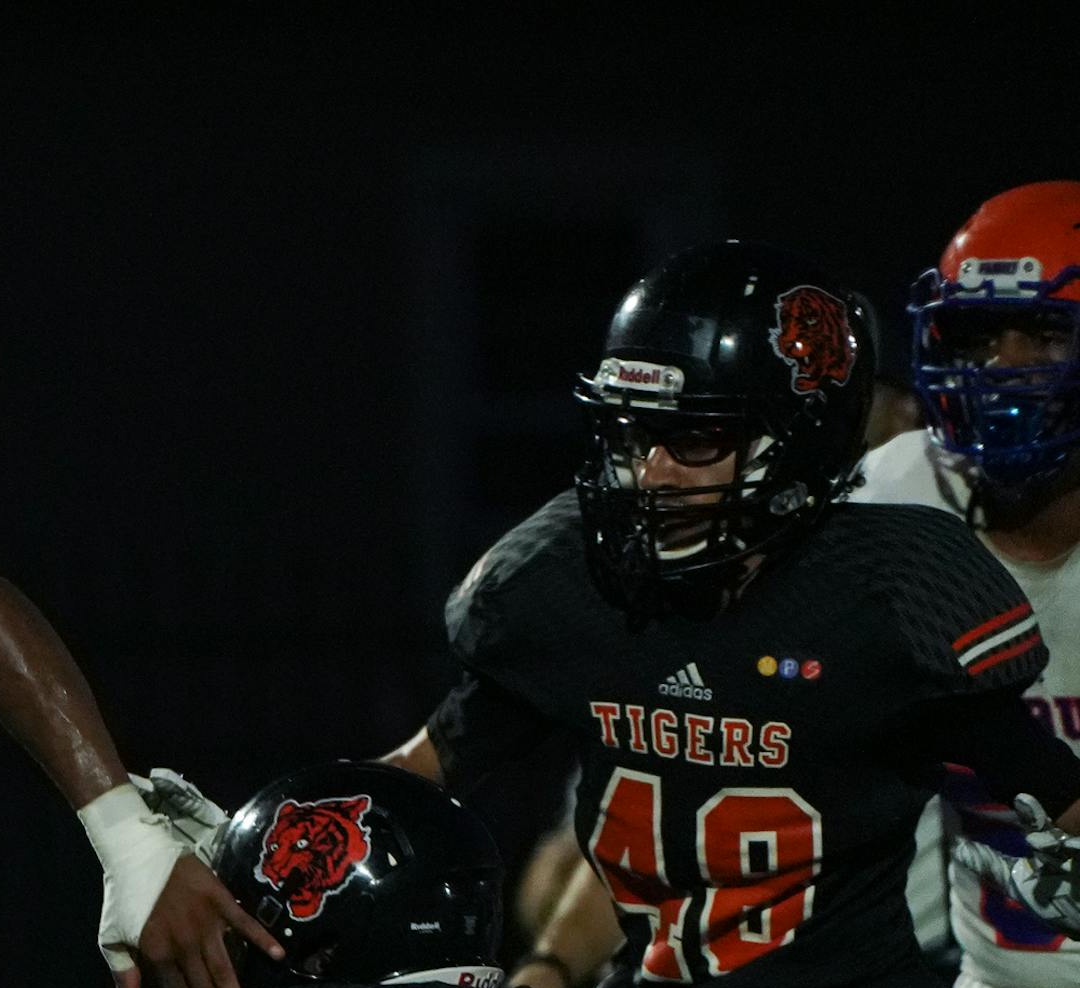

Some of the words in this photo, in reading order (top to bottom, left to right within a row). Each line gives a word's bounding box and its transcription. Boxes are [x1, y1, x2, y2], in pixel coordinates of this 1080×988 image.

[658, 682, 713, 701] adidas
[589, 701, 793, 769] TIGERS
[587, 766, 824, 985] 48
